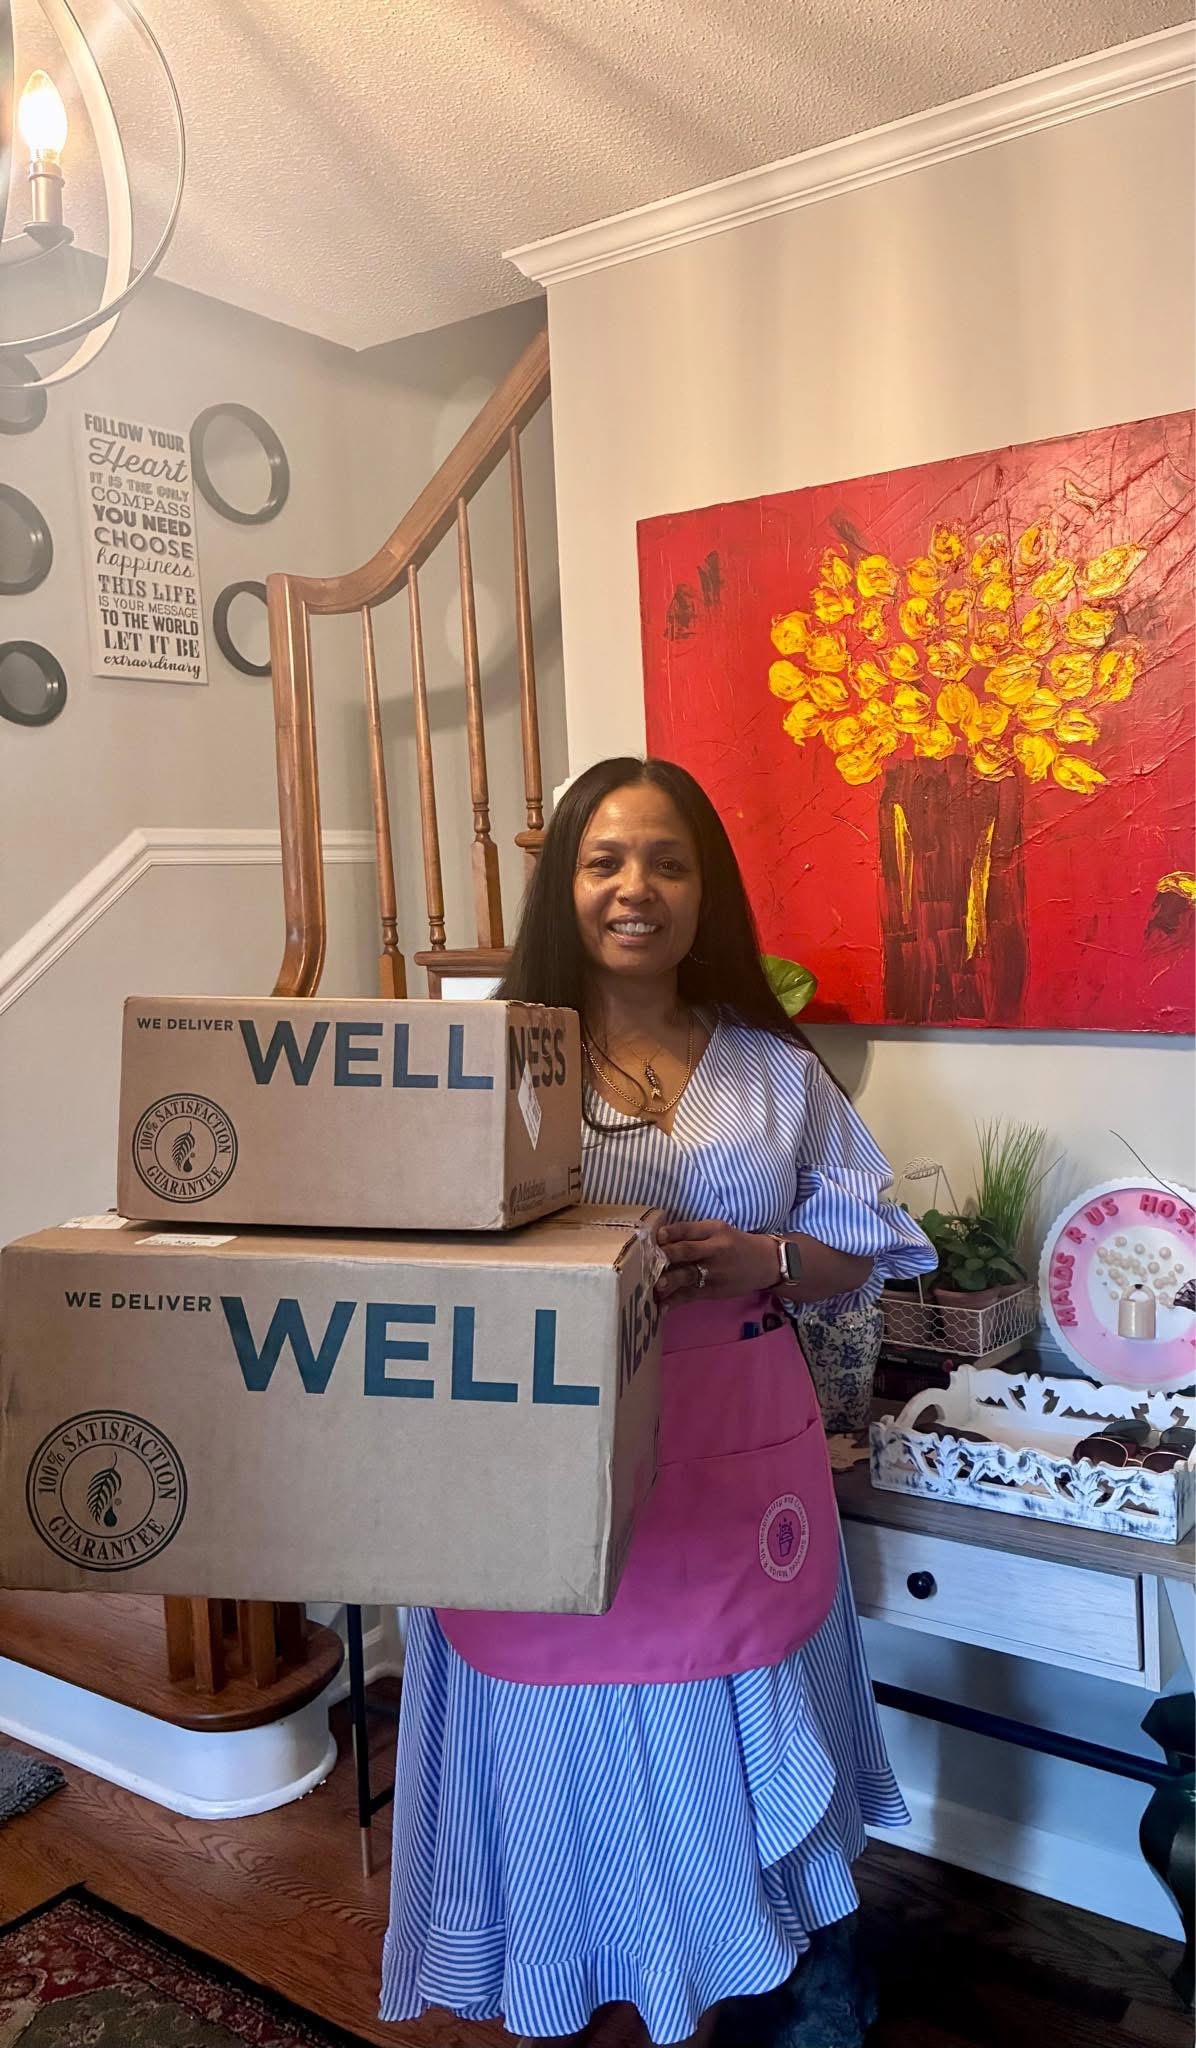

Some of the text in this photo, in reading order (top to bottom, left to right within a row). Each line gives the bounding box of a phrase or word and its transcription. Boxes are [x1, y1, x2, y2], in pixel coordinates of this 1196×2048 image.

[85, 412, 185, 453] FOLLOW YOUR
[89, 437, 188, 483] Heart
[90, 472, 189, 503] IT IS THE ONLY
[91, 486, 192, 519] COMPASS
[93, 503, 192, 537] YOU NEED
[94, 526, 194, 560] CHOOSE
[96, 546, 195, 578] happiness
[98, 574, 196, 605] THIS LIFE
[99, 594, 199, 620] IS YOUR MESSAGE
[100, 608, 199, 636] TO THE WORLD
[104, 629, 200, 659] LET IT BE
[103, 655, 201, 680] extraordinary
[136, 1017, 494, 1090] WE DELIVER WELL
[509, 1025, 567, 1090] NESS
[140, 1101, 232, 1154] 100% SATISFACTION
[146, 1165, 224, 1196] GUARANTEE
[1053, 1194, 1196, 1328] MAIDS R US HOS
[65, 1291, 600, 1406] WE DELIVER WELL
[38, 1421, 177, 1500] 100% SATISFACTION
[48, 1516, 165, 1561] GUARANTEE
